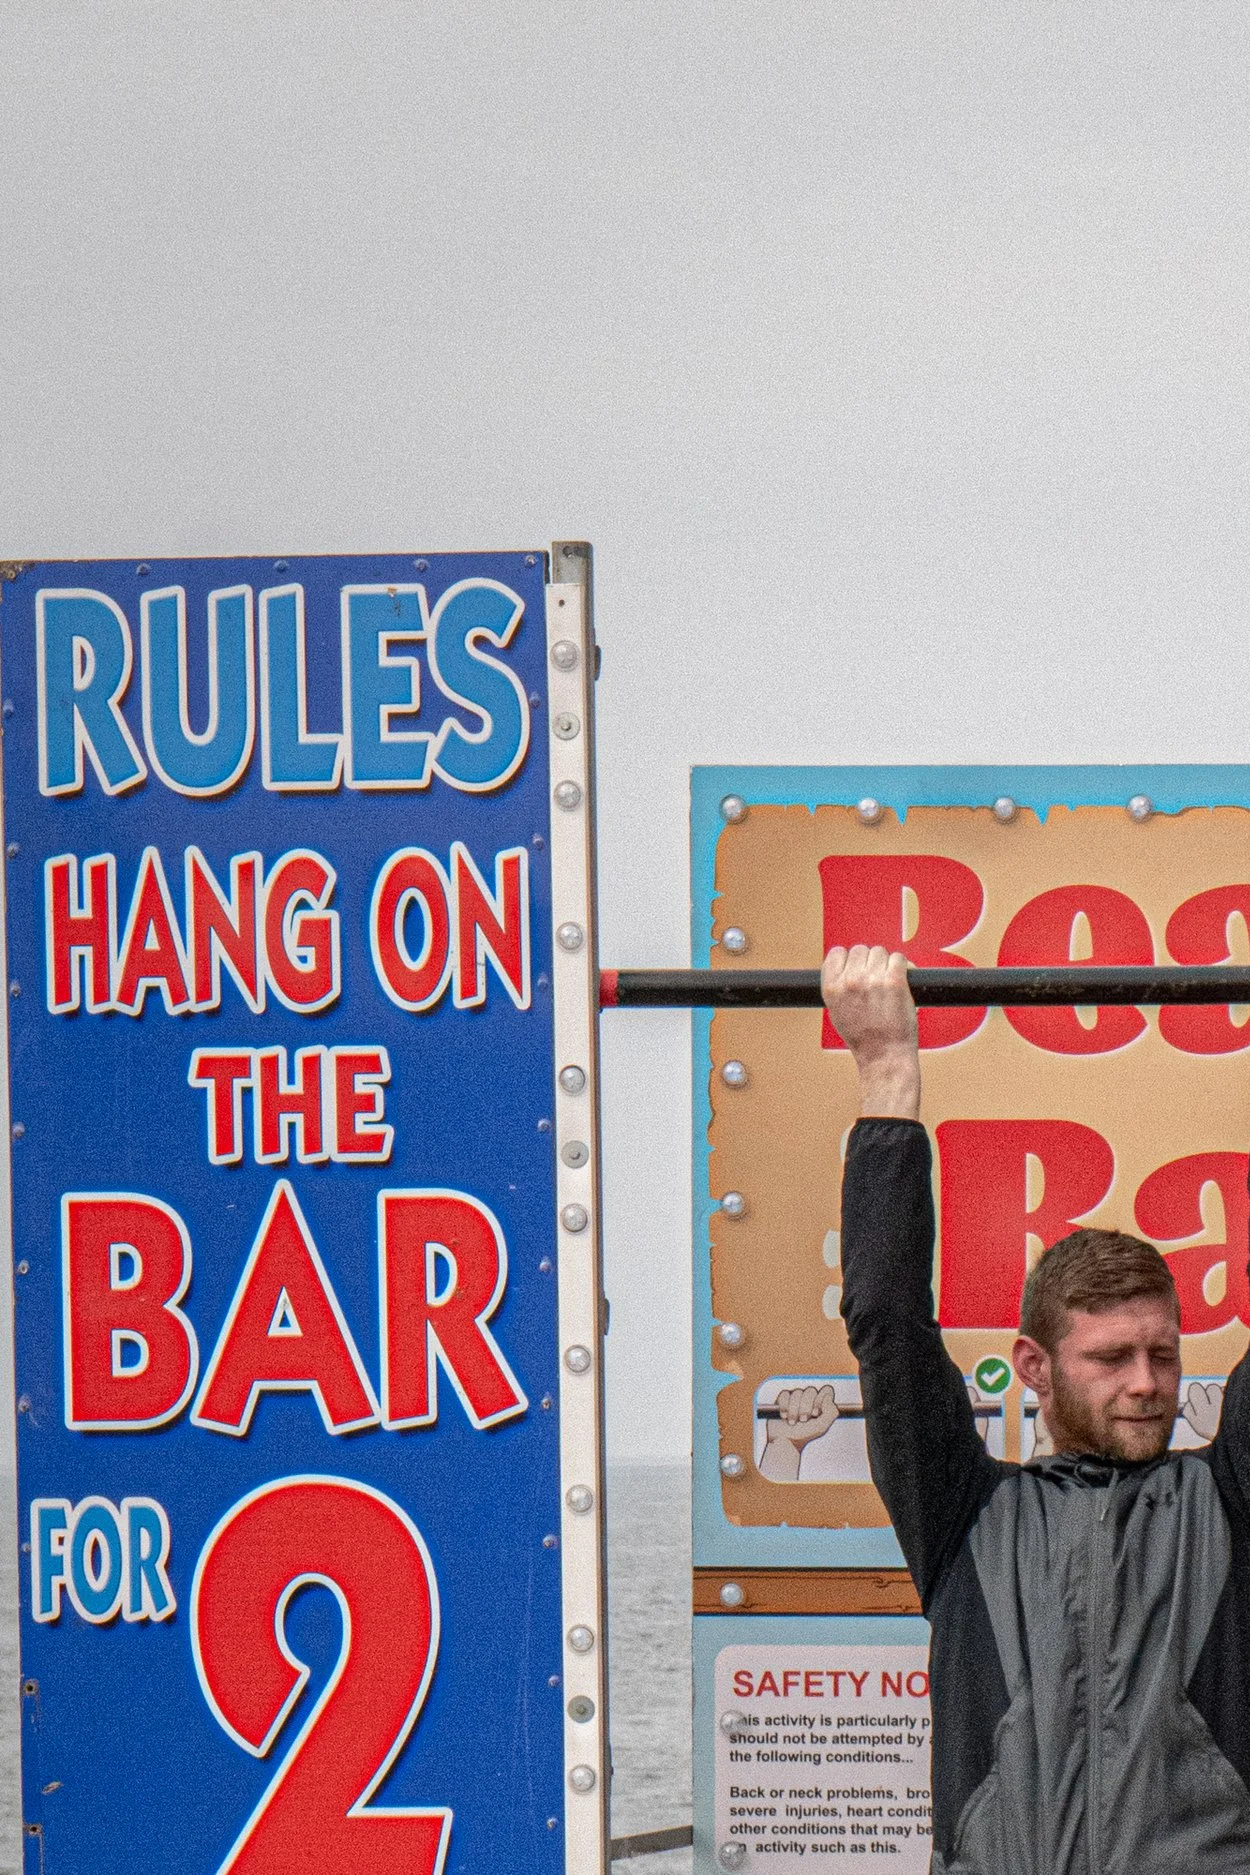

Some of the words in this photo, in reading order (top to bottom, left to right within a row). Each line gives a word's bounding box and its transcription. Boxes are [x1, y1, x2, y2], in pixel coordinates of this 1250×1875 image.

[36, 577, 530, 797] RULES
[44, 845, 341, 1014] HANG
[369, 841, 530, 1011] ON
[188, 1046, 393, 1165] THE
[61, 1179, 529, 1436] BAR
[30, 1496, 177, 1624] FOR
[733, 1671, 870, 1698] SAFETY
[881, 1671, 930, 1698] NO
[764, 1714, 815, 1728] activity
[820, 1714, 832, 1727] is
[837, 1714, 917, 1728] particularly
[730, 1732, 778, 1744] should
[783, 1734, 805, 1744] not
[810, 1733, 827, 1744] be
[832, 1733, 903, 1746] attempted
[907, 1733, 924, 1747] by
[730, 1751, 750, 1762] the
[756, 1751, 821, 1765] following
[826, 1751, 913, 1763] conditions...
[730, 1786, 765, 1799] Back
[770, 1789, 784, 1799] or
[789, 1786, 822, 1799] neck
[827, 1786, 898, 1802] problems,
[907, 1787, 930, 1799] bro
[730, 1808, 777, 1817] severe
[785, 1804, 842, 1819] injuries,
[847, 1804, 883, 1817] heart
[887, 1805, 933, 1818] condit
[730, 1822, 766, 1835] other
[772, 1822, 846, 1836] conditions
[851, 1823, 878, 1836] that
[883, 1827, 911, 1838] may
[755, 1841, 806, 1856] activity
[811, 1841, 845, 1854] such
[850, 1844, 866, 1854] as
[871, 1841, 901, 1854] this.
